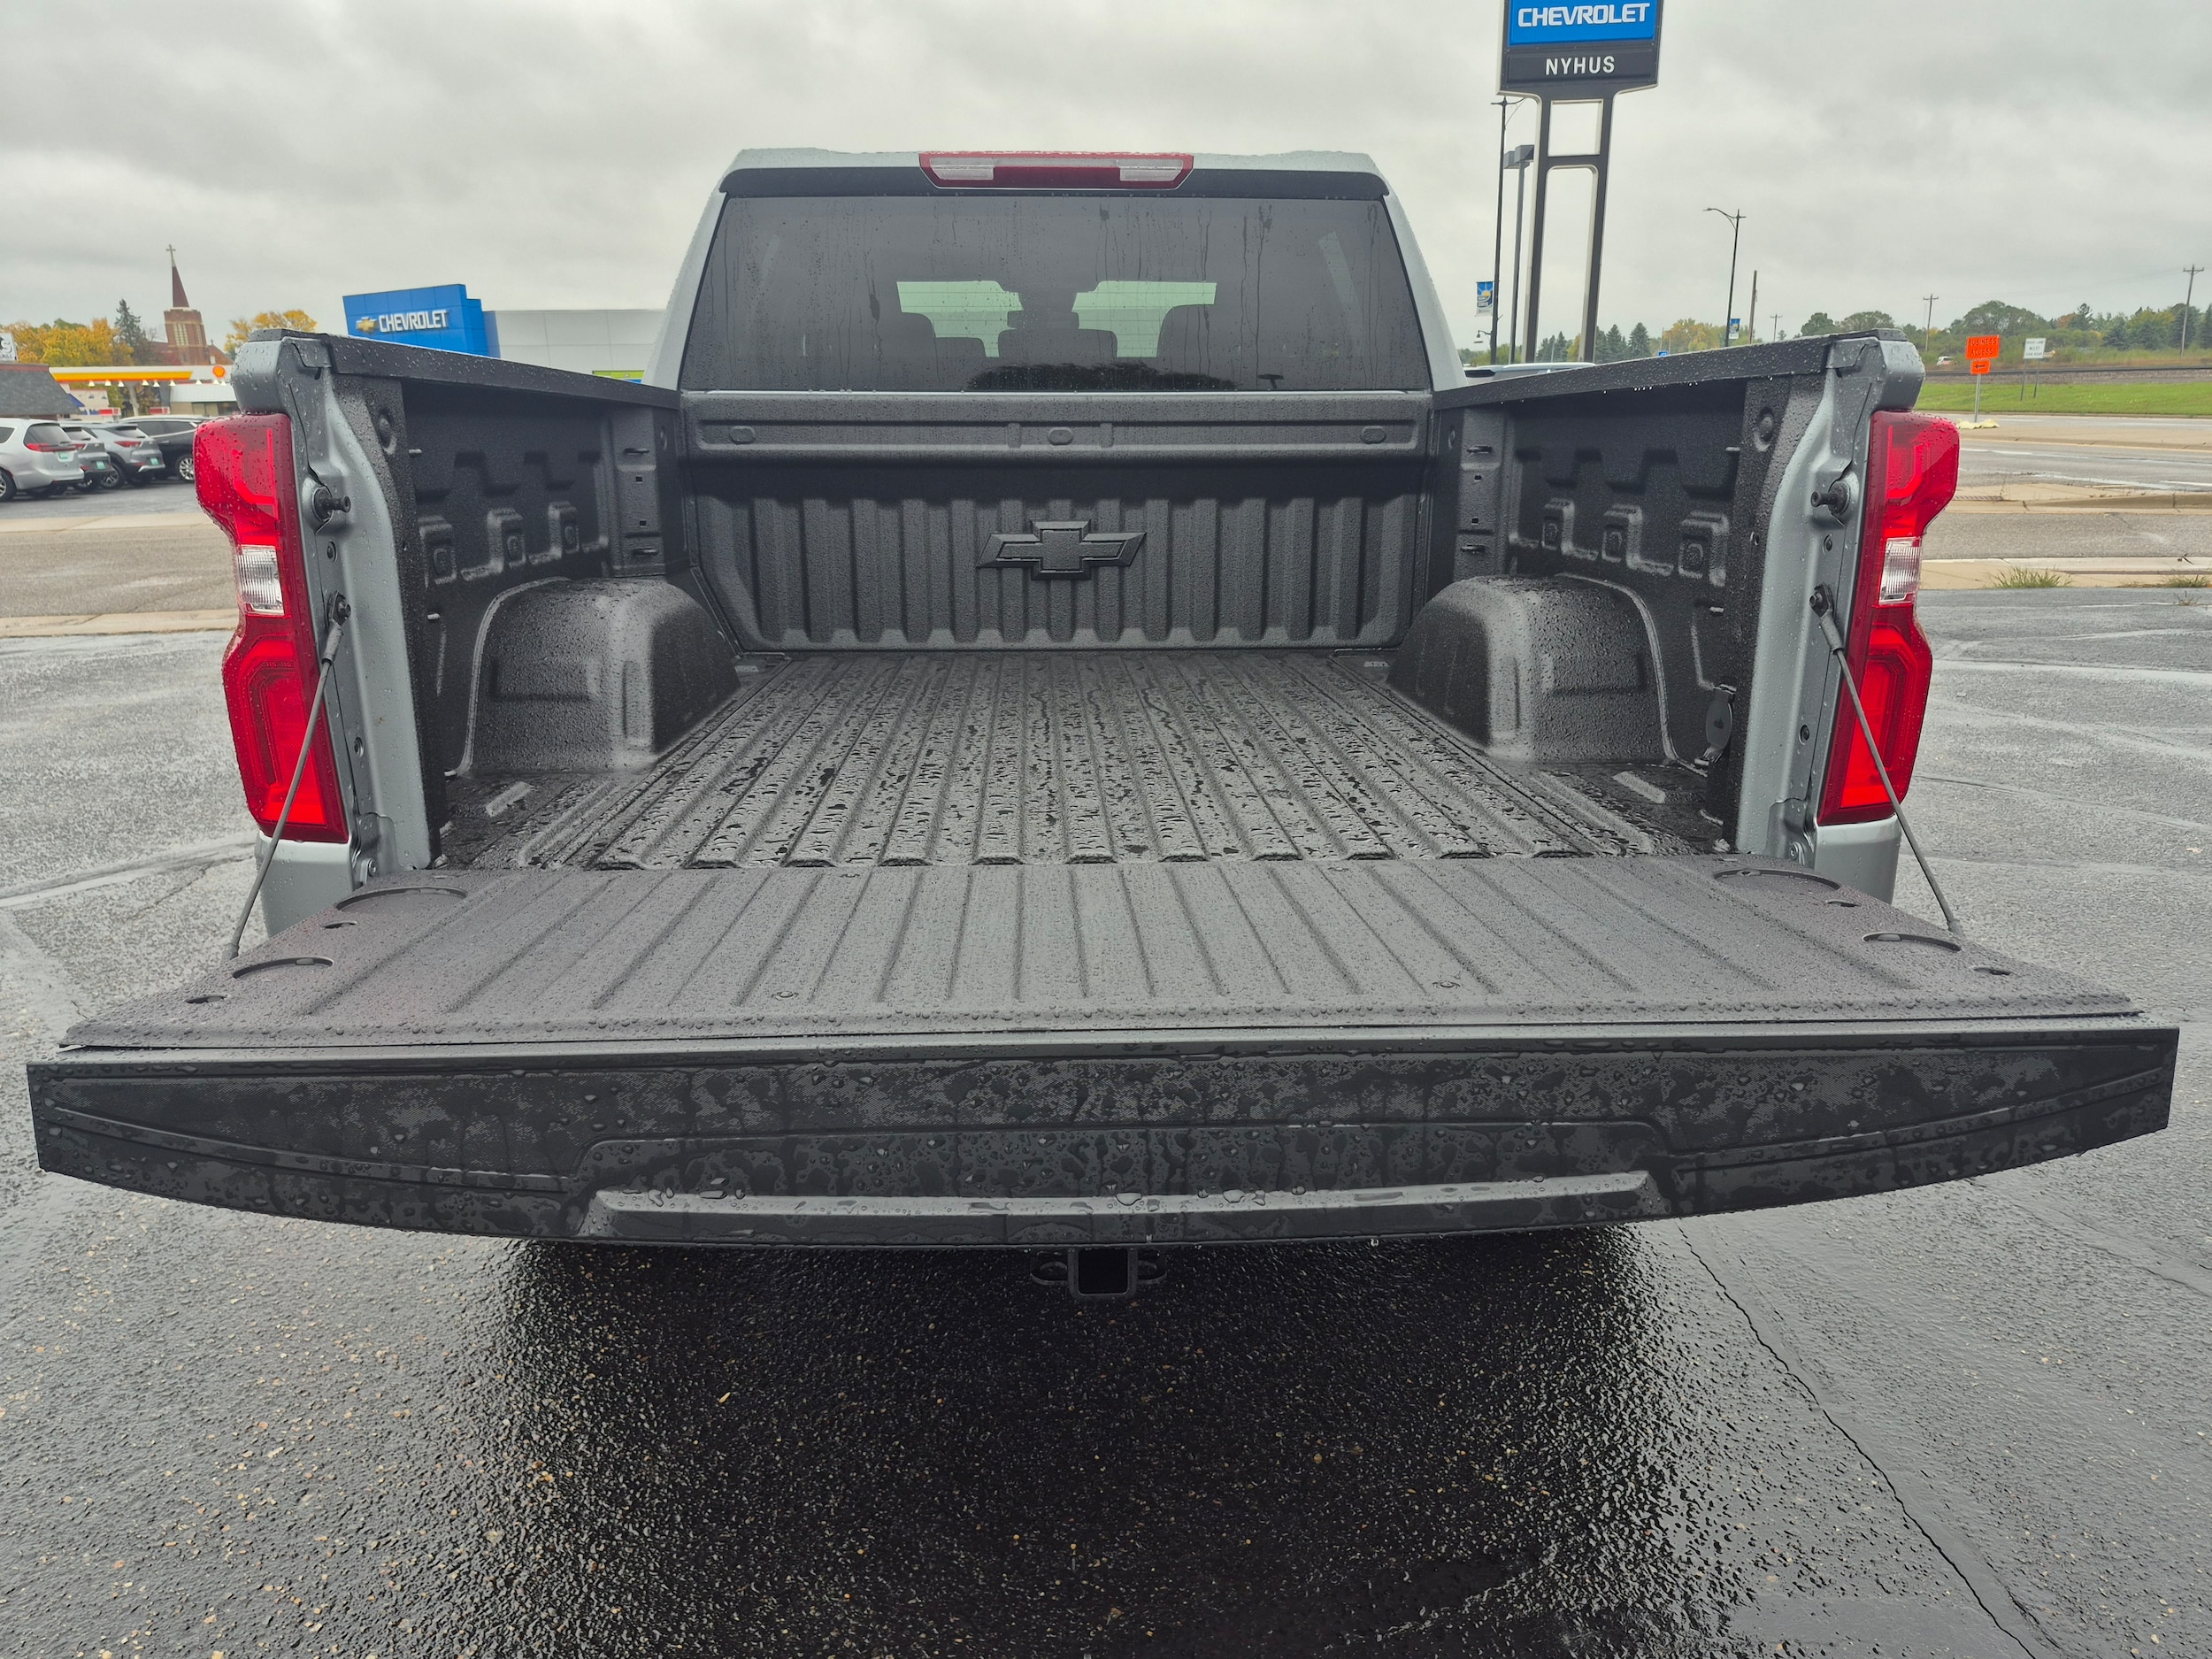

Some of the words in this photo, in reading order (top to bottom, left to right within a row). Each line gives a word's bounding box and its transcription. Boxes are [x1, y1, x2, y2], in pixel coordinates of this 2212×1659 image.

[1518, 3, 1650, 27] CHEVROLET
[1546, 56, 1615, 75] NYHUS
[379, 310, 447, 332] CHEVROLET
